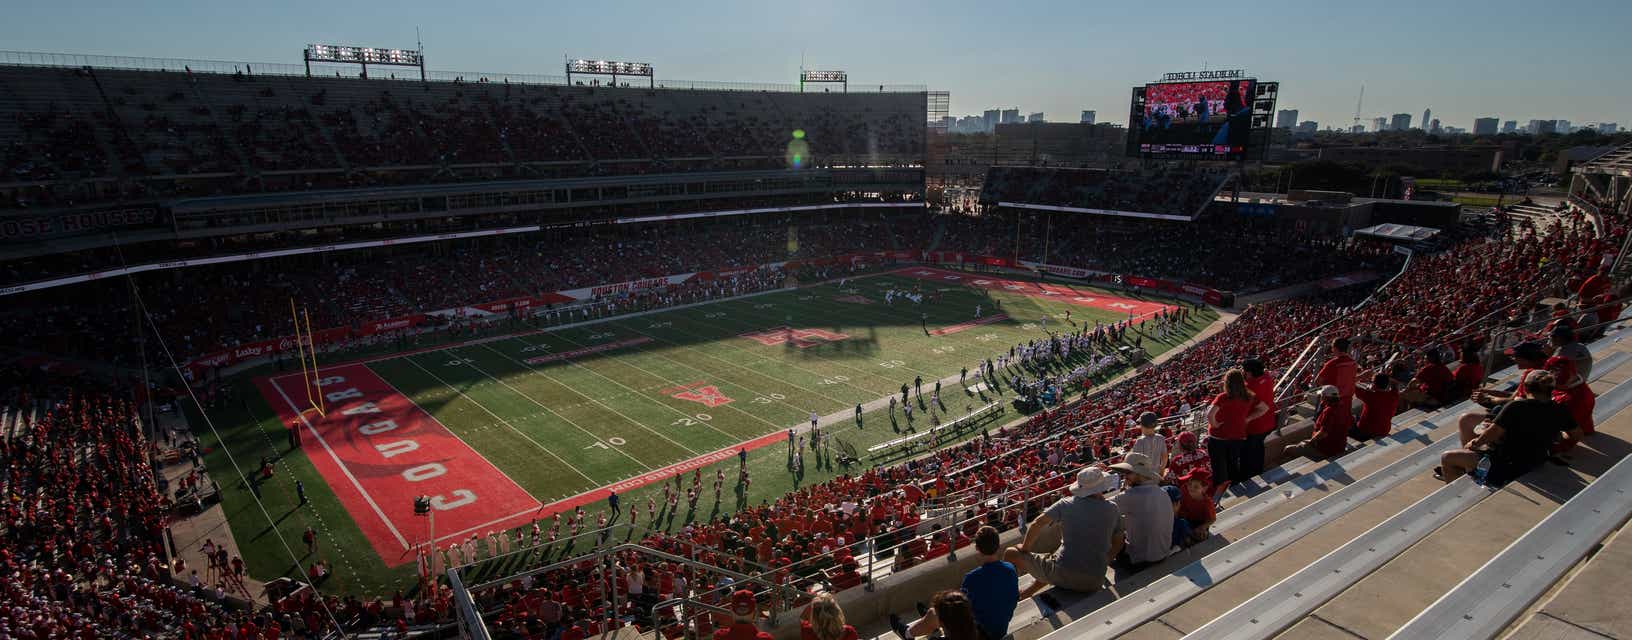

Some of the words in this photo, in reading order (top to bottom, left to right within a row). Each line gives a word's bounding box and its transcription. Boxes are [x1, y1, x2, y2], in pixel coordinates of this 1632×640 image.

[1198, 69, 1240, 79] STADIUM
[591, 281, 629, 297] HOUSTON
[751, 392, 787, 404] 30
[671, 412, 713, 427] 20
[314, 375, 478, 511] COUGARS
[583, 436, 628, 450] 10
